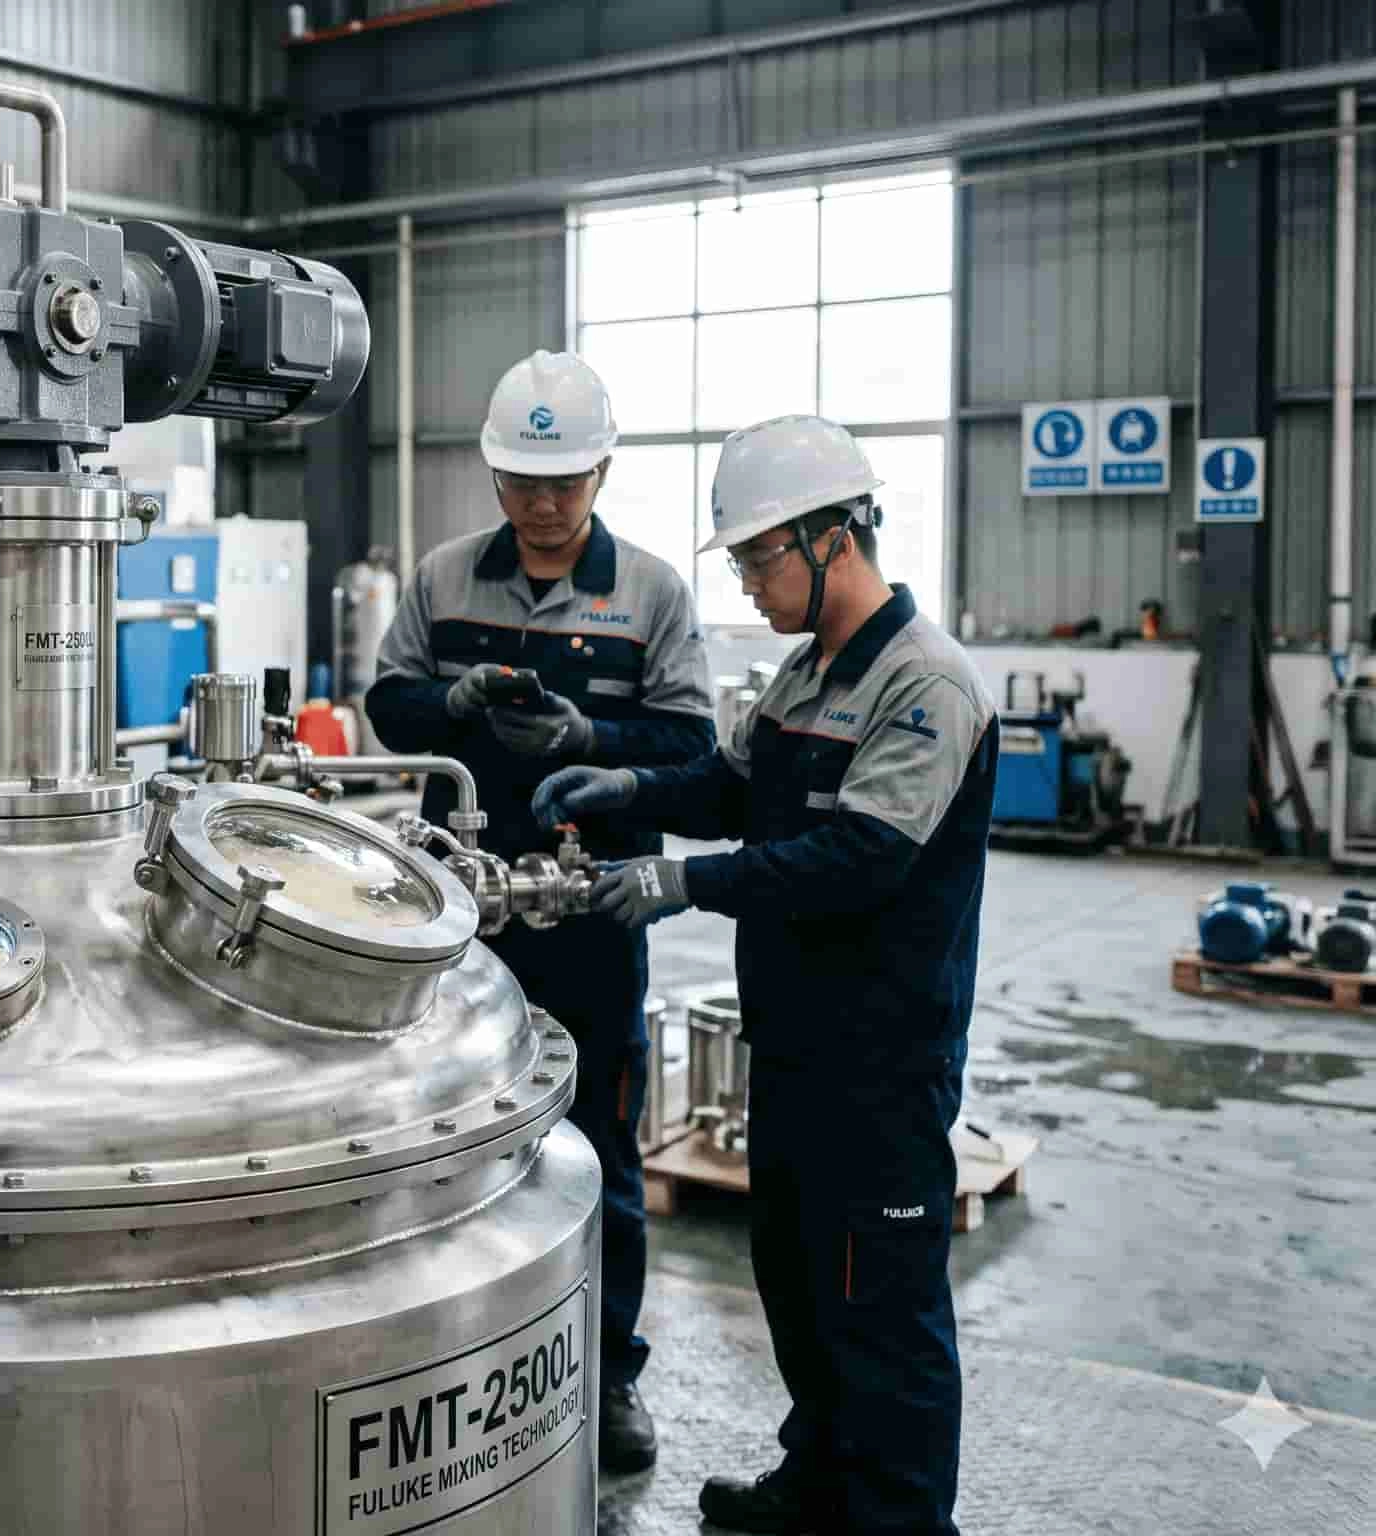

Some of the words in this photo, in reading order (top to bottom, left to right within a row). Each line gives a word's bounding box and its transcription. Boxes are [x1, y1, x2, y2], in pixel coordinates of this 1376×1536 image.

[348, 1323, 580, 1481] FMT-2500L
[348, 1472, 433, 1521] FULUKE
[438, 1444, 499, 1493] MIXING
[501, 1383, 580, 1462] TECHNOLOGY
